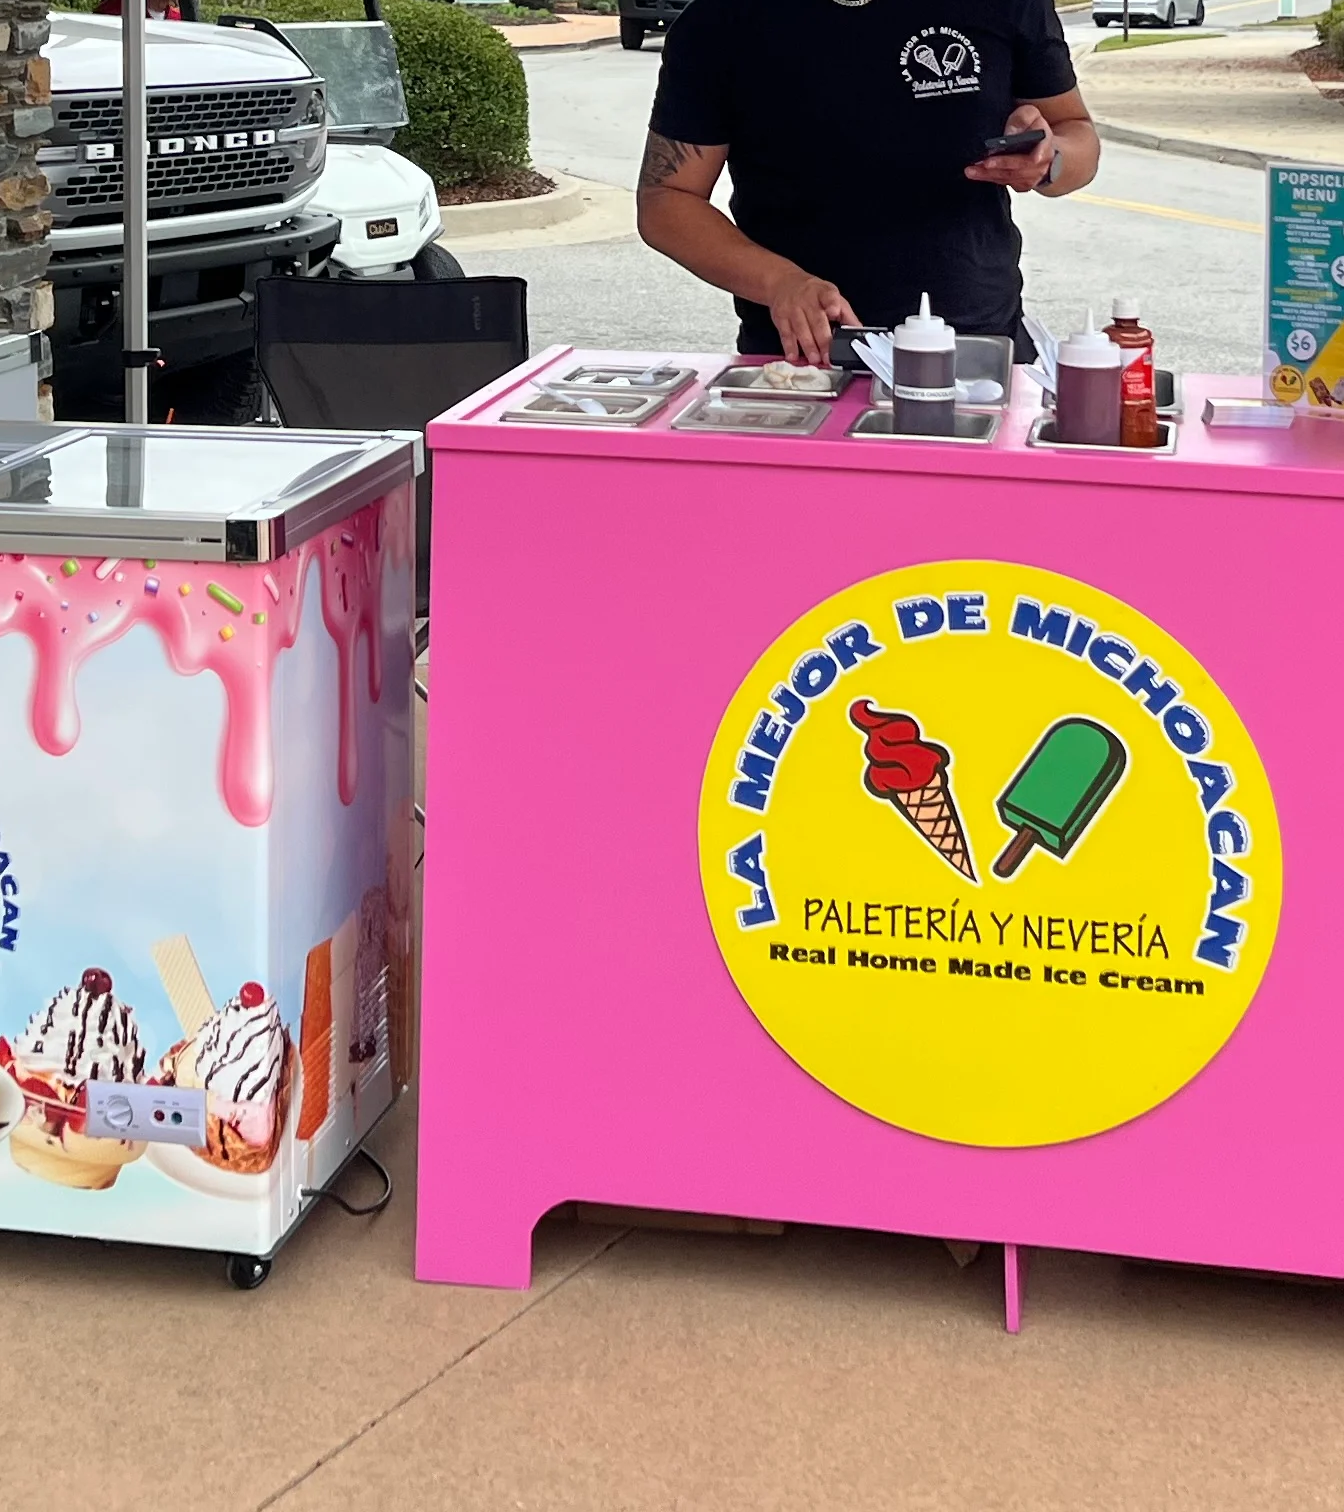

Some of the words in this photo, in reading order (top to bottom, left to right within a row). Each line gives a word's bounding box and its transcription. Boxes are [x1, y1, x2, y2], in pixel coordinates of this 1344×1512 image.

[899, 35, 920, 65] MEJOR
[920, 26, 936, 38] DE
[939, 26, 981, 73] MICHOACAN
[901, 68, 913, 82] LA
[85, 129, 276, 160] BONCO
[1292, 188, 1337, 202] MENU
[1291, 332, 1311, 352] $6
[891, 590, 989, 642] DE
[728, 618, 884, 813] MEJOR
[1008, 593, 1254, 973] MICHOACAN
[726, 830, 778, 931] LA
[803, 897, 980, 945] PALETERÍA
[989, 911, 1015, 948] Y
[1022, 911, 1170, 960] NEVERÍA
[769, 942, 837, 967] Real
[846, 948, 938, 974] Home
[947, 956, 1033, 983] Made
[1042, 964, 1088, 987] Ice
[1098, 970, 1206, 996] Cream
